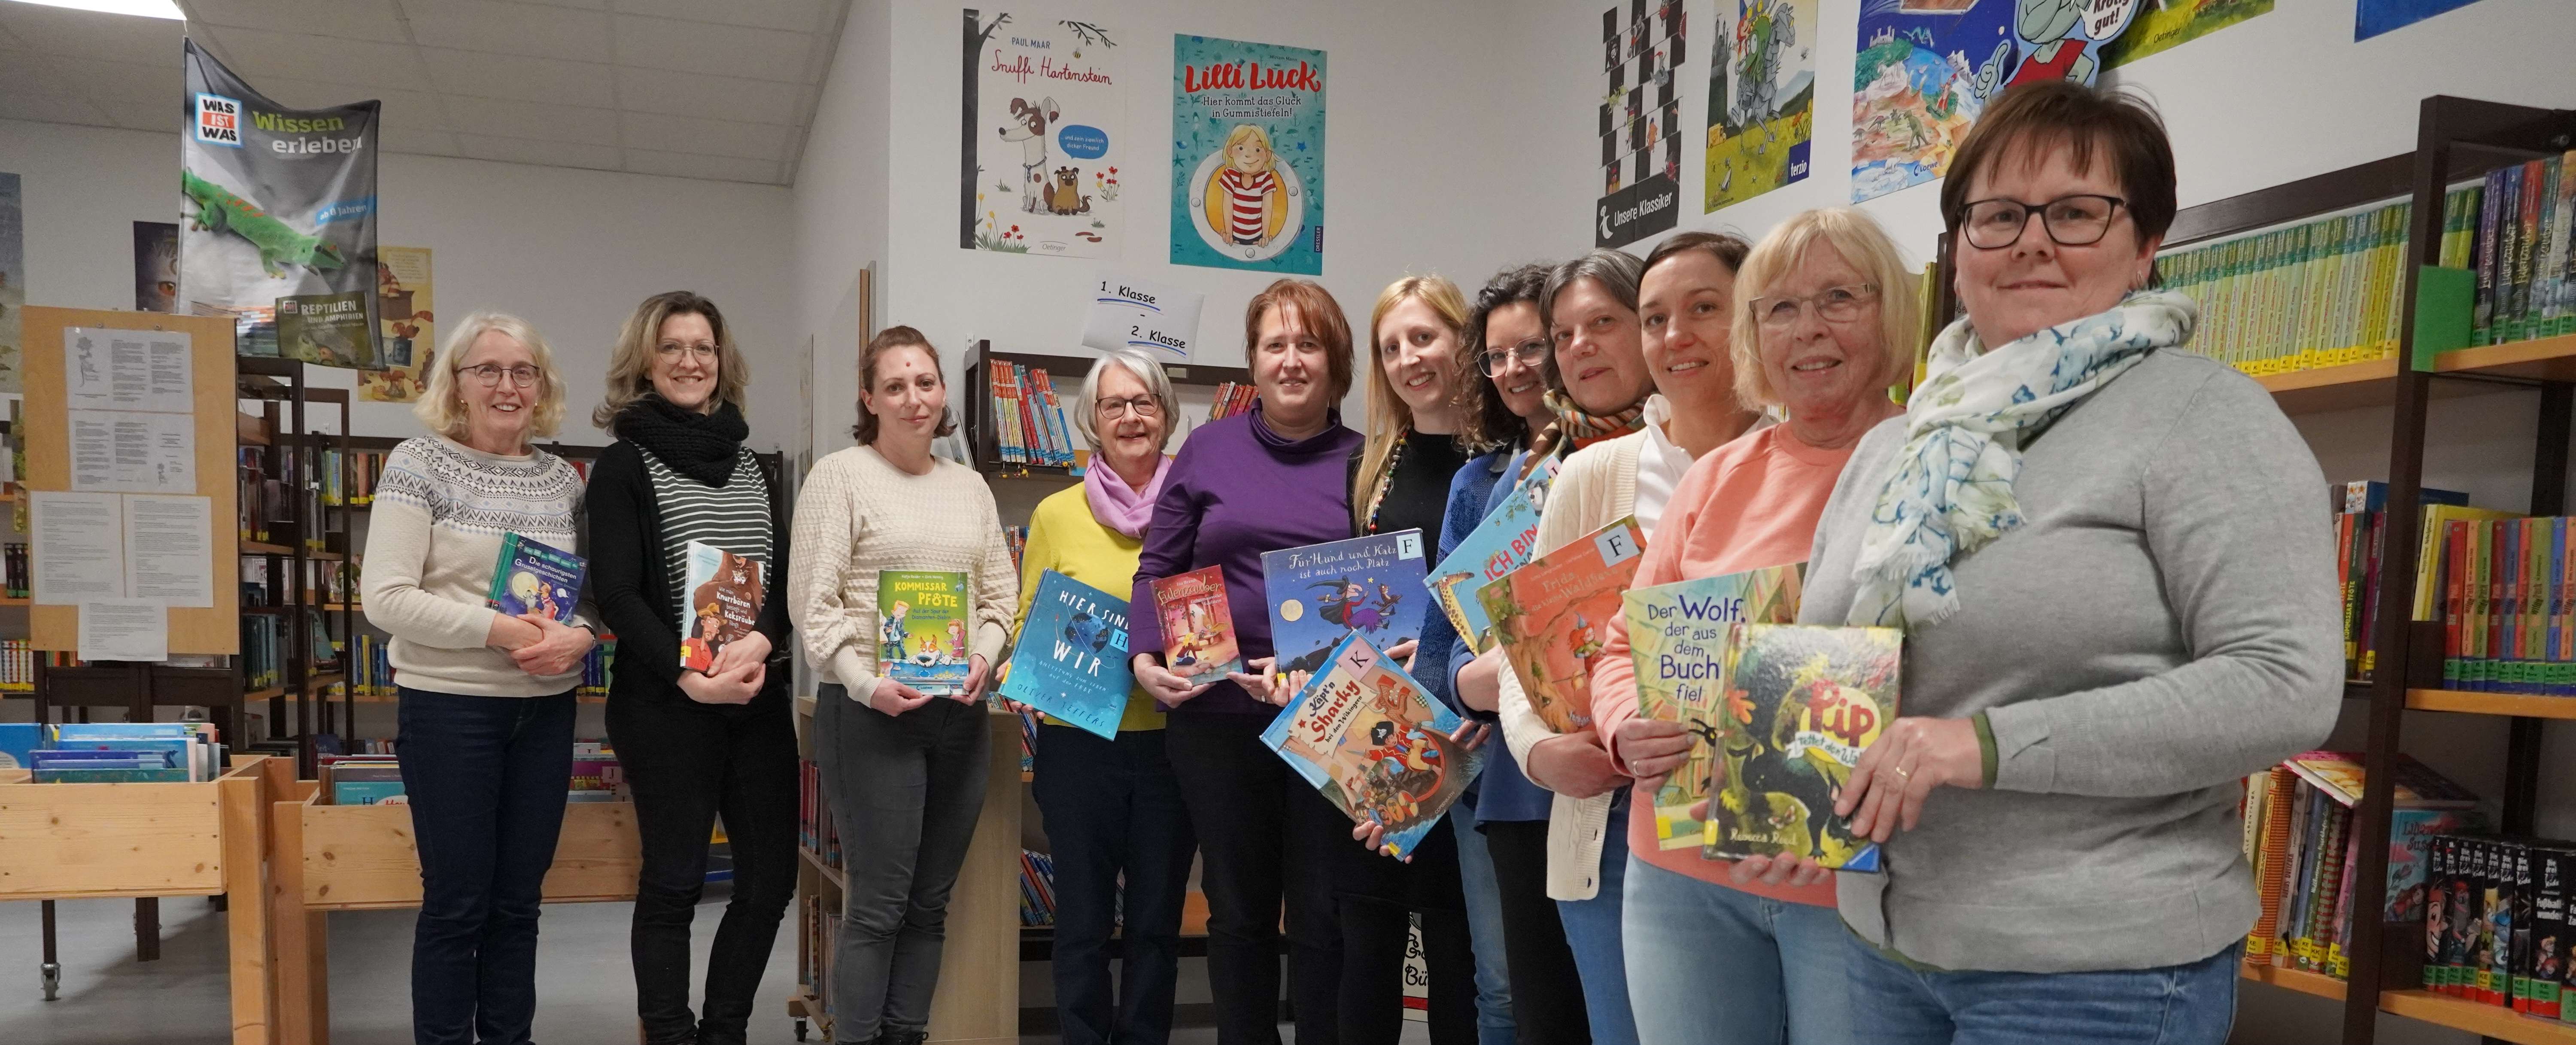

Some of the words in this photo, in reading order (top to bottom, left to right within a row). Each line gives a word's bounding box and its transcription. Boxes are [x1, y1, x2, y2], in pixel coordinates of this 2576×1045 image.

[2094, 7, 2120, 36] gut!
[1012, 37, 1029, 47] PAUL
[1030, 39, 1051, 49] MAAR
[2154, 27, 2181, 43] Oetinger
[992, 49, 1034, 84] Snuffi
[1041, 56, 1112, 85] Hartenstein
[1185, 63, 1245, 93] Lilli
[1250, 61, 1321, 92] Luck
[203, 99, 234, 113] WAS
[1202, 96, 1223, 106] Hier
[1225, 95, 1255, 106] kommt
[1258, 96, 1273, 106] das
[1275, 95, 1302, 106] Glück
[211, 115, 229, 127] IST
[1212, 108, 1221, 118] in
[1223, 107, 1292, 118] Gummistiefeln!
[252, 111, 344, 133] Wissen
[202, 127, 237, 141] WAS
[272, 137, 362, 153] erleben
[1790, 159, 1807, 177] terzio
[320, 211, 328, 220] ab
[337, 204, 367, 216] Jahren
[1614, 208, 1638, 227] Unsere
[1639, 191, 1672, 217] Klassiker
[1042, 243, 1066, 252] Oetinger
[1101, 281, 1111, 293] 1.
[1118, 285, 1155, 304] Klasse
[301, 301, 356, 315] REPTILIEN
[325, 313, 363, 322] AMPHIBIEN
[1131, 326, 1142, 338] 2.
[1149, 330, 1185, 348] Klasse
[1402, 539, 1413, 554] F
[1484, 550, 1514, 581] ICH
[1511, 523, 1538, 556] BIN
[1607, 535, 1622, 558] F
[1289, 552, 1311, 569] Für
[1312, 550, 1344, 566] Hund
[1348, 546, 1371, 559] und
[1373, 544, 1397, 557] Katz
[515, 558, 568, 583] Gruselgeschichten
[529, 556, 541, 566] Die
[541, 564, 577, 580] schaurigsten
[1299, 571, 1311, 579] ist
[1315, 566, 1337, 577] auch
[1340, 564, 1364, 574] noch
[1367, 558, 1390, 569] Platz
[895, 582, 948, 592] KOMMISSAR
[1157, 574, 1222, 606] Eulenzauber
[717, 592, 750, 608] Knurrbären
[1059, 590, 1096, 614] HIER
[725, 610, 755, 626] Keksräube
[1648, 604, 1677, 620] Der
[2344, 603, 2353, 640] KOMMISSAR
[1115, 633, 1127, 648] H
[1665, 623, 1689, 637] der
[1692, 628, 1716, 641] aus
[1674, 640, 1704, 657] dem
[1053, 640, 1101, 677] WIR
[1349, 650, 1370, 668] K
[1661, 655, 1719, 680] Buch
[1018, 684, 1052, 703] OLIVER
[1309, 681, 1335, 717] Käpt'n
[1676, 684, 1702, 702] fiel
[1311, 680, 1361, 742] Sharky
[1325, 732, 1334, 743] bei
[1333, 721, 1343, 734] den
[1340, 696, 1363, 724] Wikingern
[1804, 678, 1874, 748] Pip
[1825, 743, 1841, 755] den
